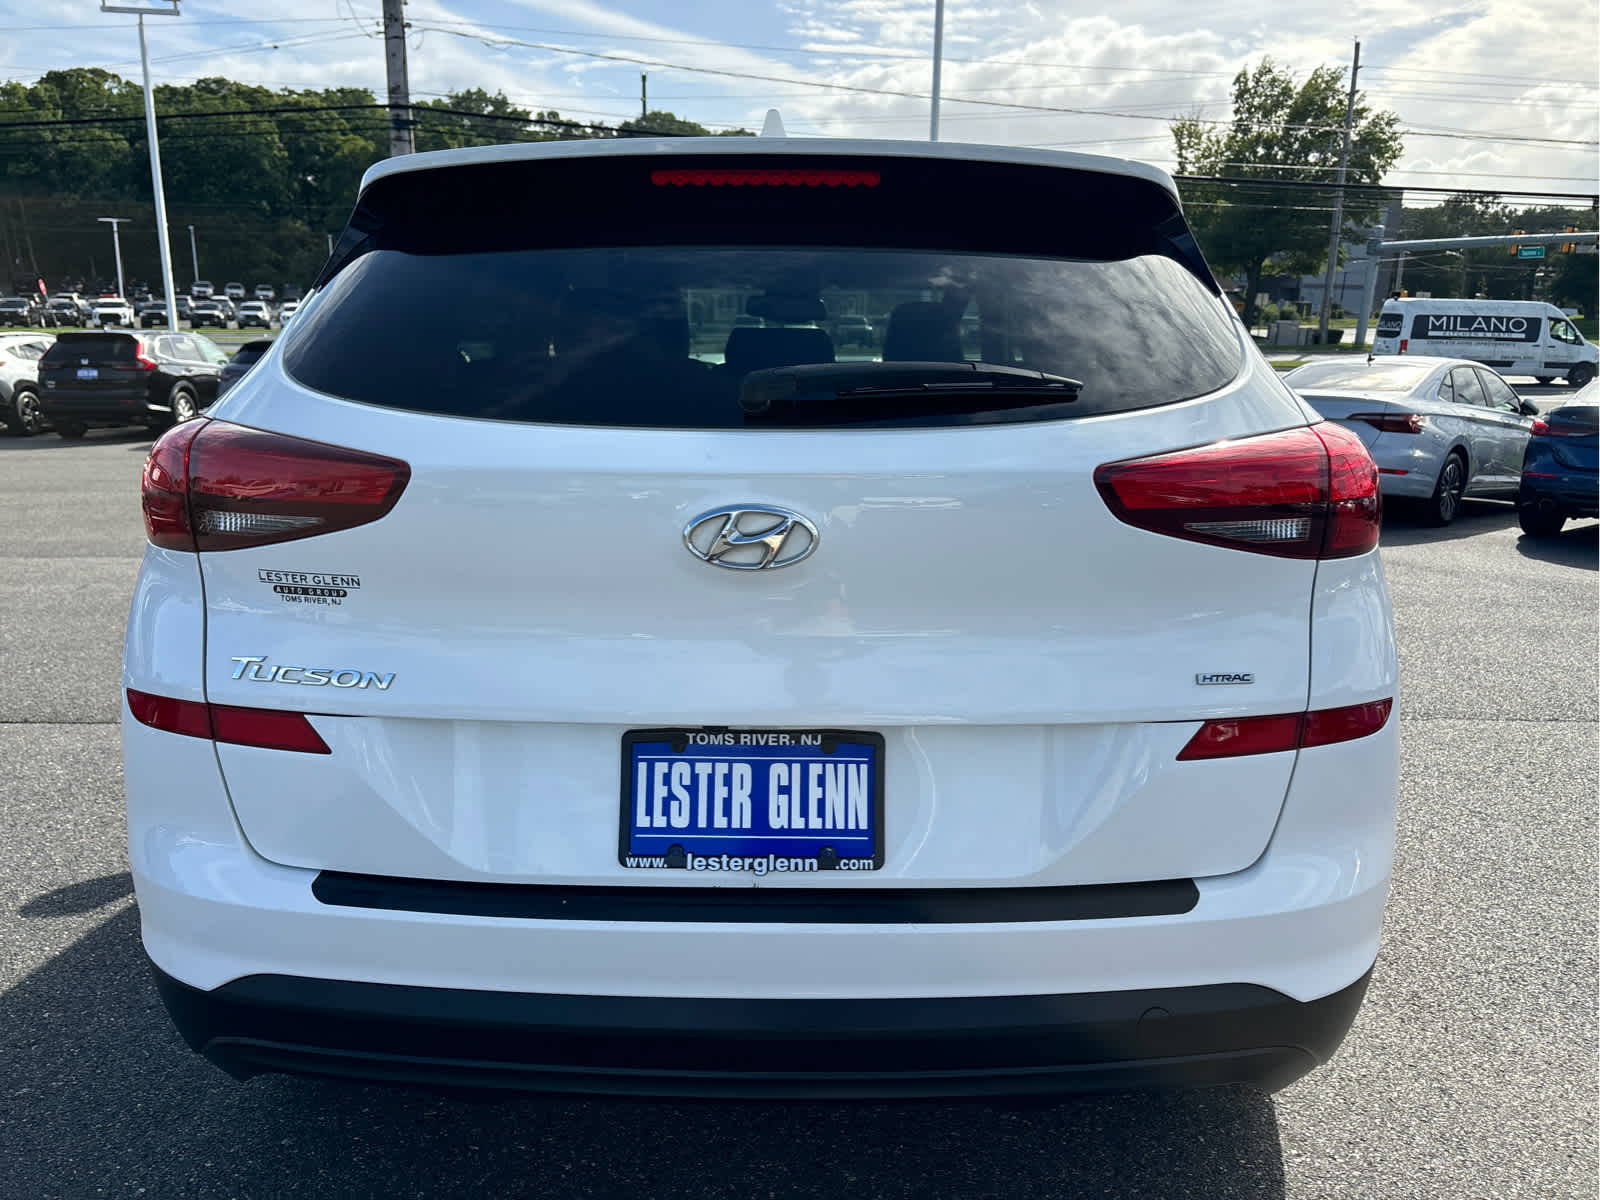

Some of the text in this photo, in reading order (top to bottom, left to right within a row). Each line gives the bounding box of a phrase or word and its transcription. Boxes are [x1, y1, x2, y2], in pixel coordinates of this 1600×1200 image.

[1428, 316, 1527, 332] MILANO
[258, 572, 360, 587] LESTER GLENN
[276, 586, 346, 597] AUTO GROUP
[281, 595, 342, 606] TOMS RIVER, NJ
[232, 655, 396, 690] TUCSON
[1202, 673, 1251, 682] HTRAC
[686, 733, 822, 747] TOMS RIVER, NJ
[636, 761, 868, 830] LESTER GLENN
[686, 853, 818, 876] lesterglenn
